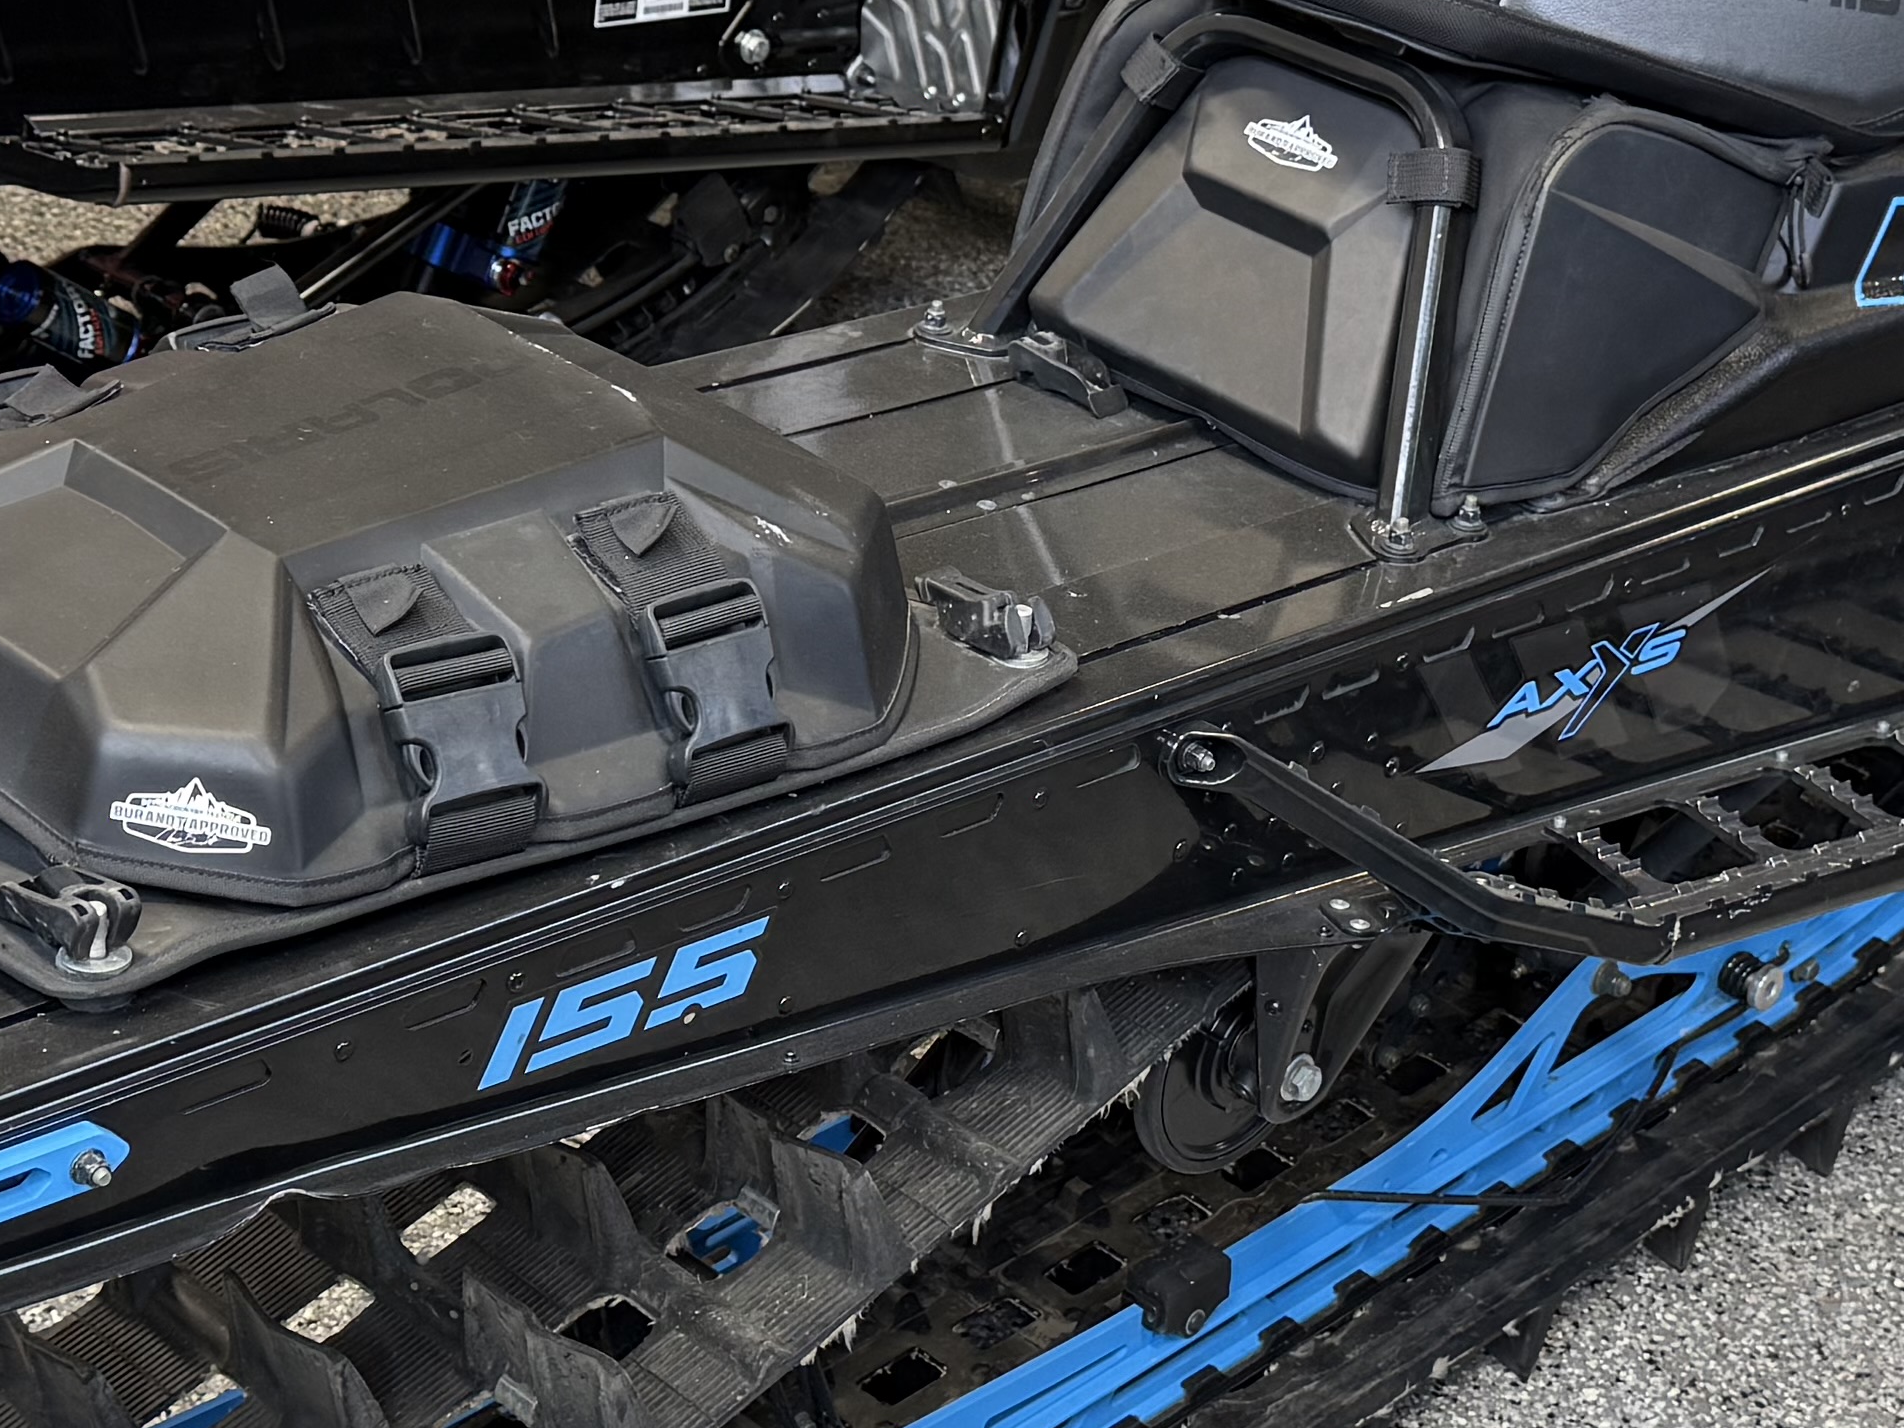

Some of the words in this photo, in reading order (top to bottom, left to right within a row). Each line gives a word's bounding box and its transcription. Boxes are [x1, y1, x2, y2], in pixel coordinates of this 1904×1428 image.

[1487, 622, 1687, 741] AXYS
[113, 805, 187, 830] BURANDT
[189, 817, 269, 842] APPROVED
[477, 915, 771, 1091] 155
